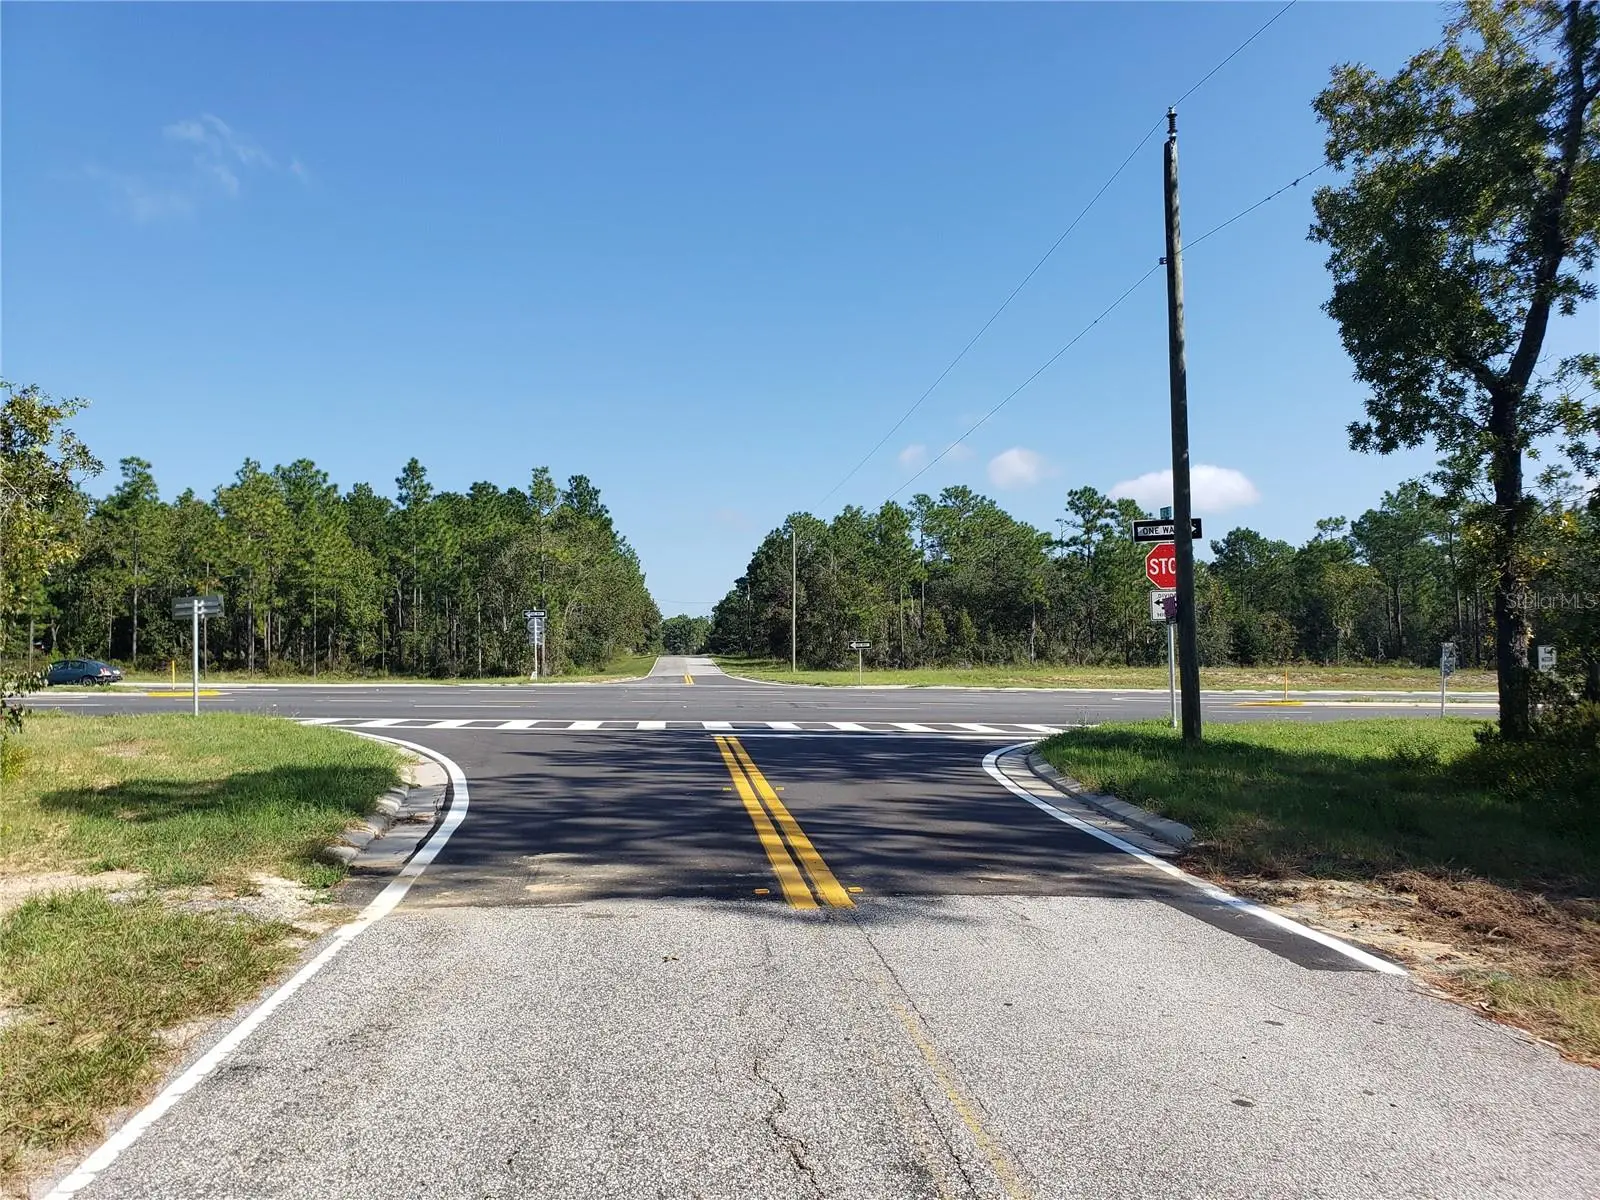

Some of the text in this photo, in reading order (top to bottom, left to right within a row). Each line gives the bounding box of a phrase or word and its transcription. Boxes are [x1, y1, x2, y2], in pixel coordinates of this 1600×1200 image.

[1142, 525, 1175, 535] ONE WA
[1149, 557, 1176, 575] STO
